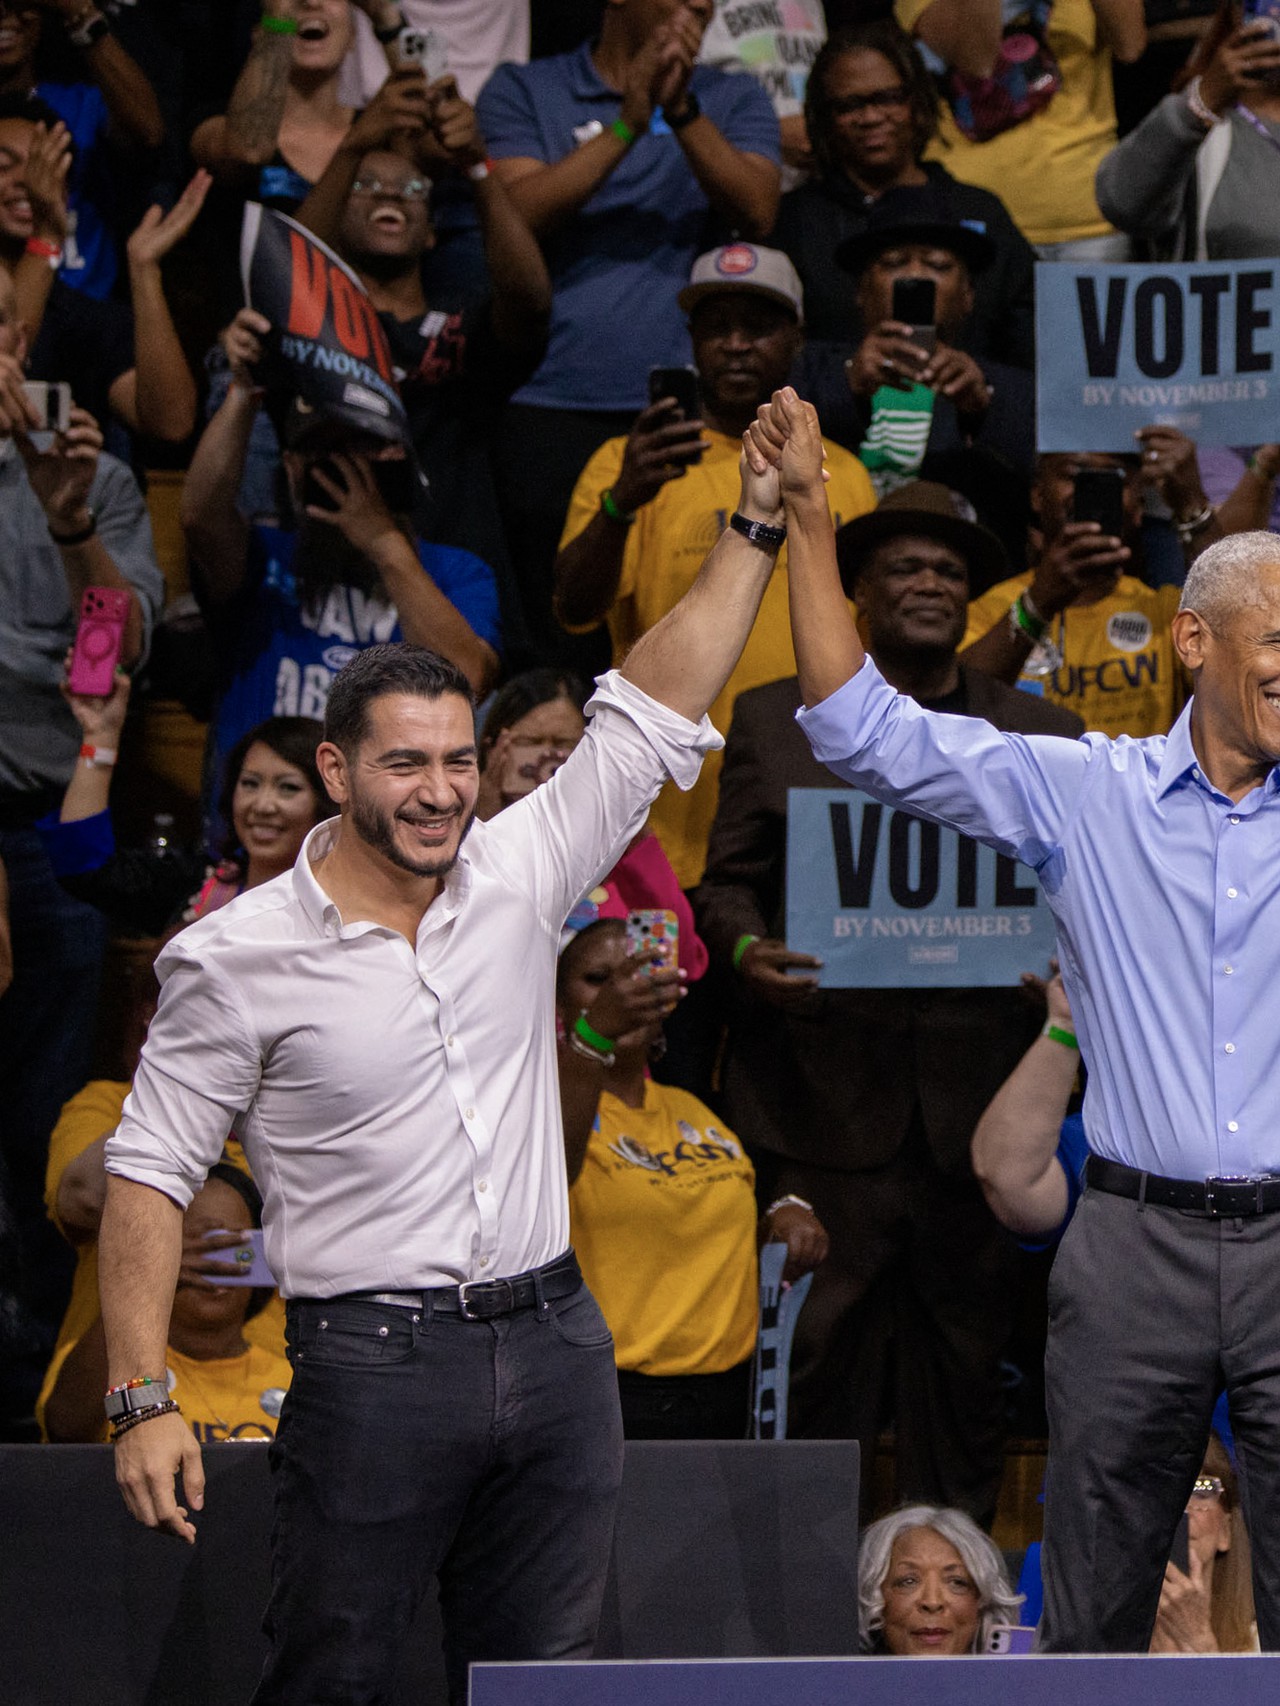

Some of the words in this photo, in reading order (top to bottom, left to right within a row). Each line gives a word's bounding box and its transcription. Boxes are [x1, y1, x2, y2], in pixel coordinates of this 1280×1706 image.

[288, 231, 397, 386] VOT
[1076, 271, 1274, 379] VOTE
[1082, 382, 1116, 407] BY
[1120, 379, 1250, 407] NOVEMBER
[1253, 378, 1269, 400] 3
[1051, 652, 1158, 698] UFCW
[833, 916, 868, 938] BY
[871, 915, 1013, 938] NOVEMBER
[1016, 914, 1032, 936] 3
